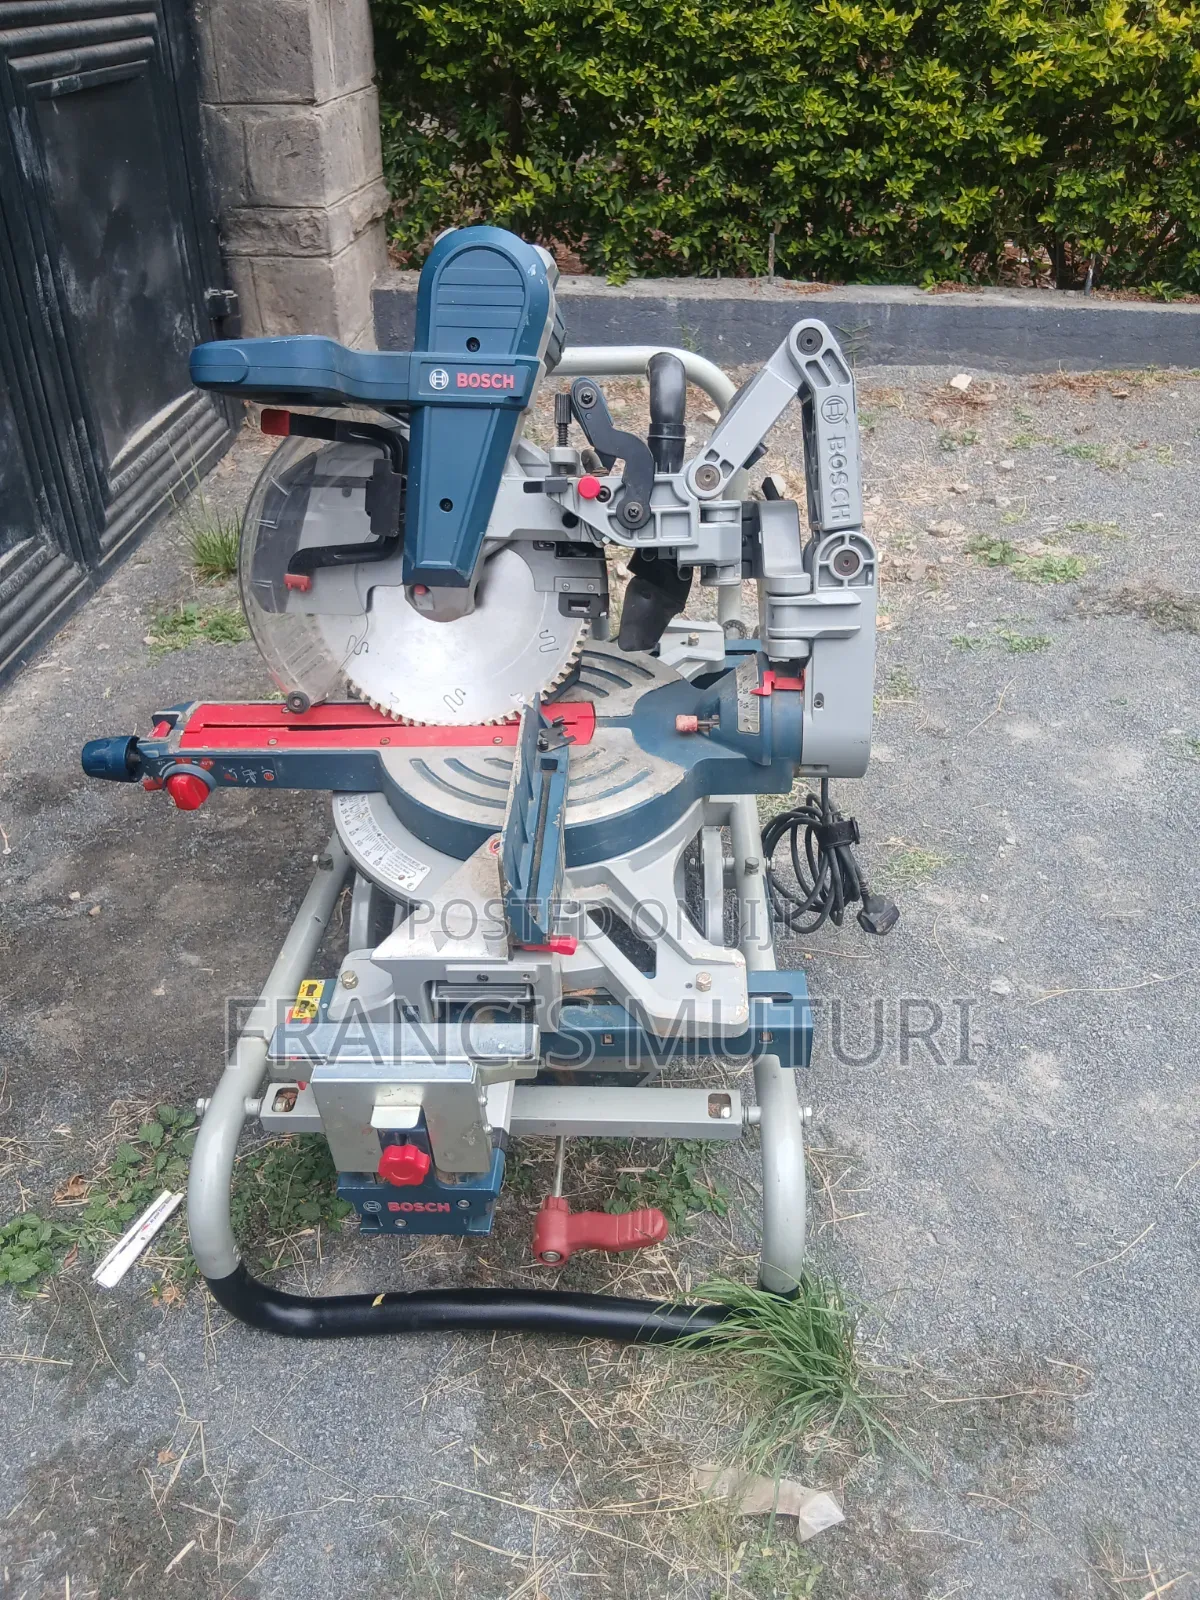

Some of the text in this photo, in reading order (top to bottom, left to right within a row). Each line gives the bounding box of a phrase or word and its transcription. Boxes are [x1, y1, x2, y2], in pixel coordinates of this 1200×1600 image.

[456, 372, 515, 390] BOSCH
[827, 436, 850, 522] BOSCH
[387, 1201, 451, 1213] BOSCH
